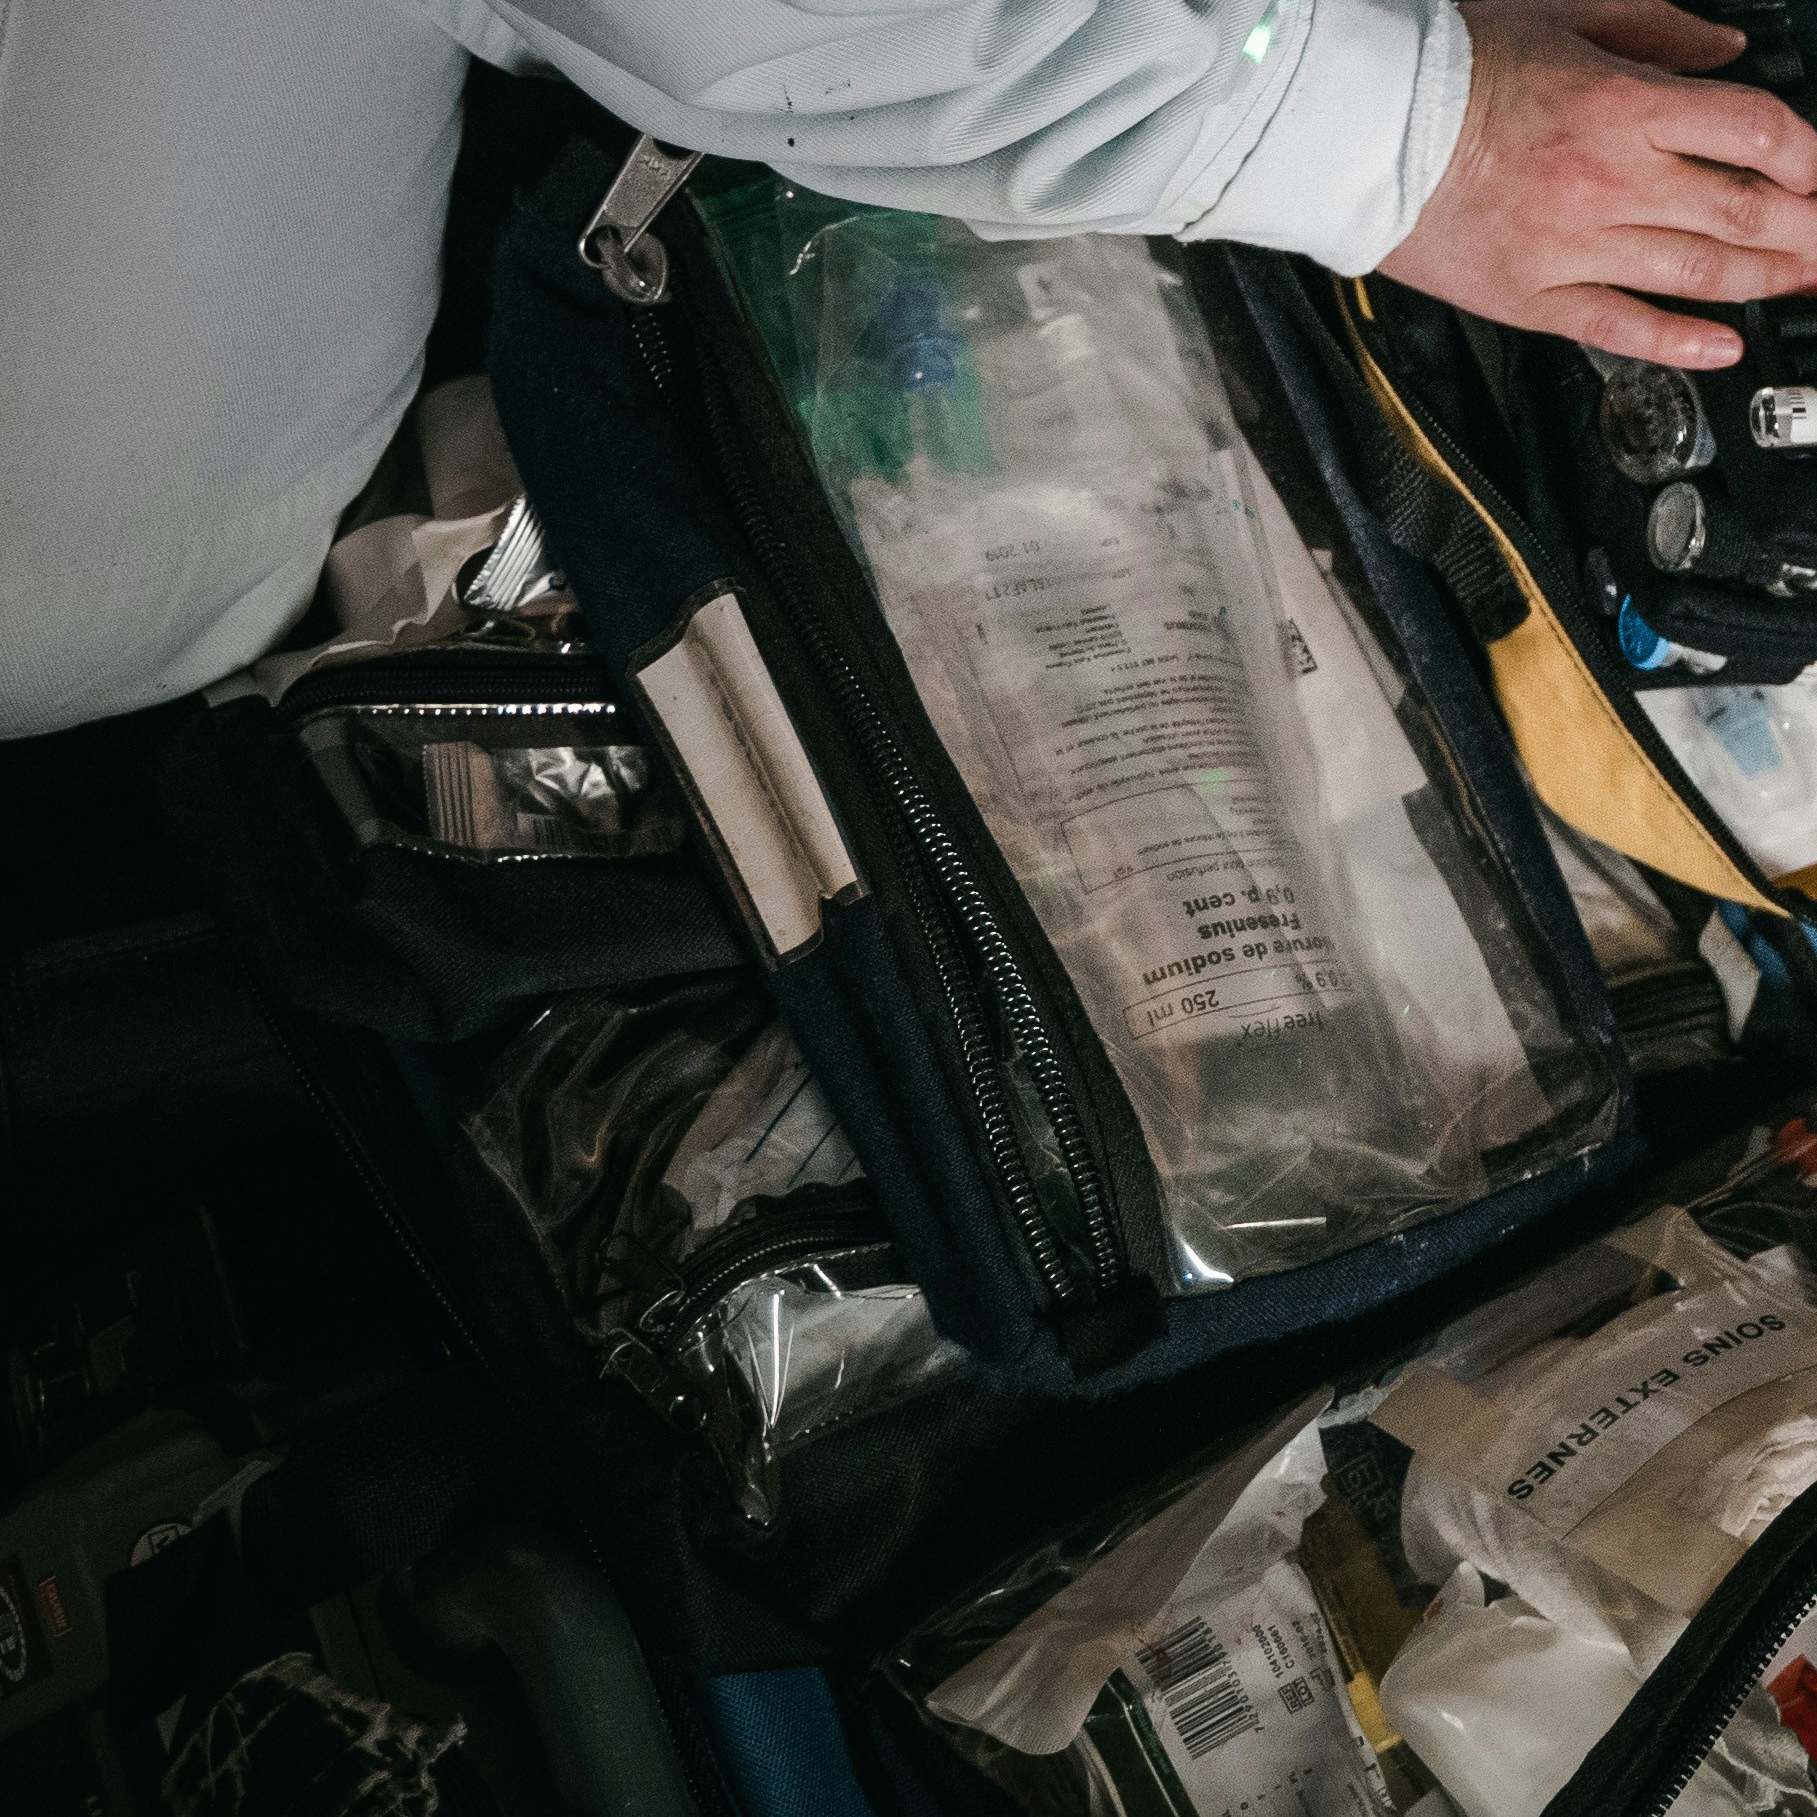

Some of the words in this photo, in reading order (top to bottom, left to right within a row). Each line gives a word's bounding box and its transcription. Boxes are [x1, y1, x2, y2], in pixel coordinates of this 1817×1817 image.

[1181, 890, 1237, 919] cent
[1263, 883, 1296, 906] 0,9
[1196, 909, 1301, 943] Fresenius
[1240, 940, 1269, 961] de
[1140, 946, 1236, 985] sodium
[1145, 1001, 1175, 1027] ml
[1178, 987, 1220, 1015] 250
[1680, 1316, 1787, 1369] SOINS
[1503, 1366, 1681, 1506] EXTERNES
[1281, 1684, 1300, 1709] REF
[1291, 1676, 1312, 1702] LOT
